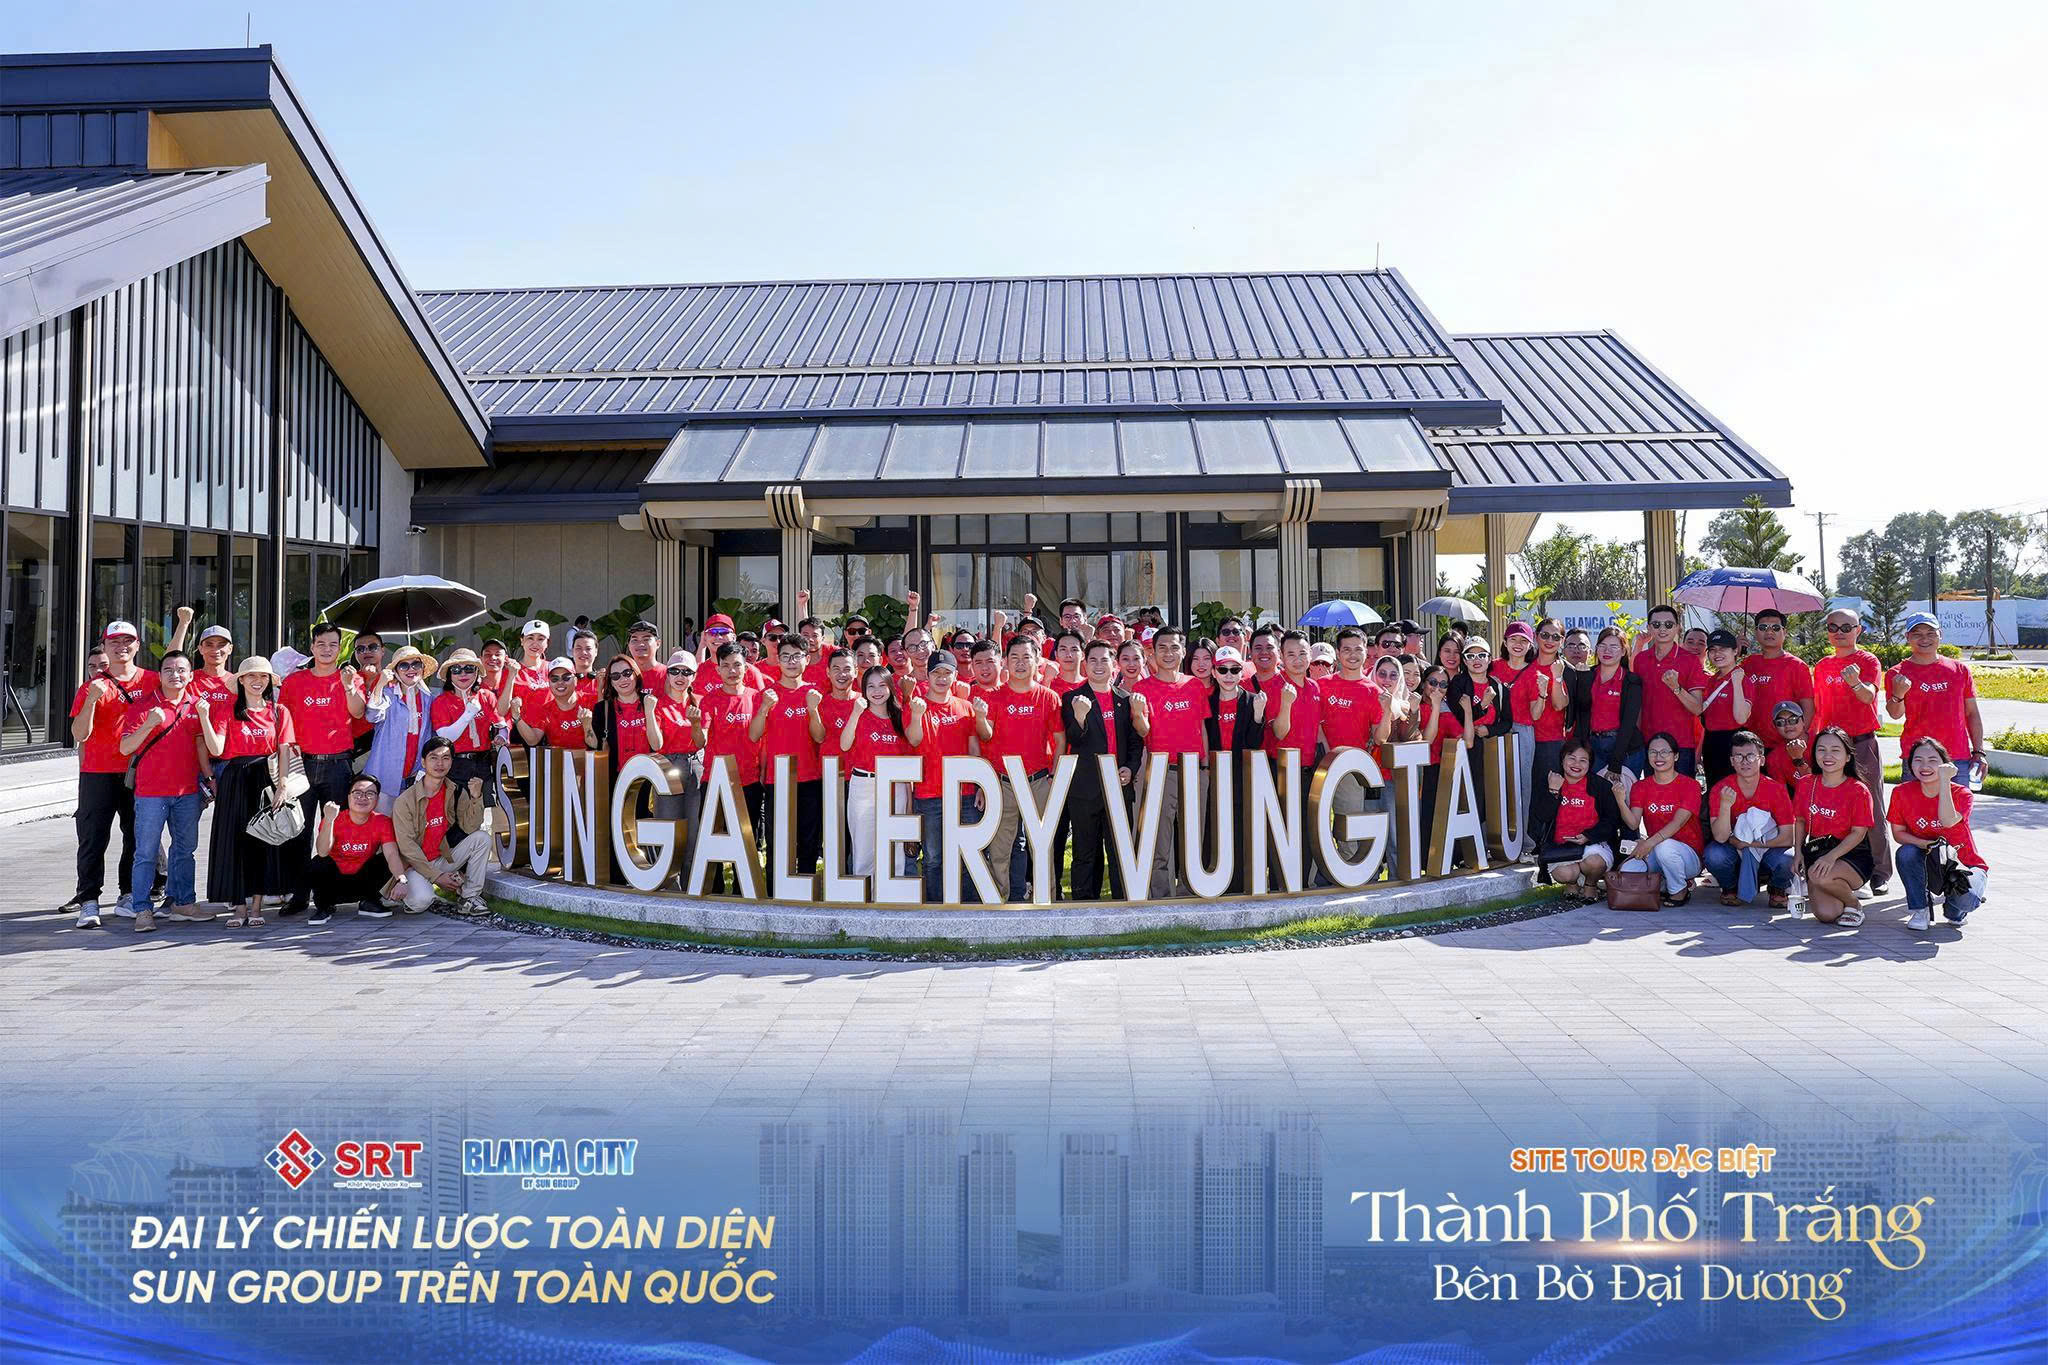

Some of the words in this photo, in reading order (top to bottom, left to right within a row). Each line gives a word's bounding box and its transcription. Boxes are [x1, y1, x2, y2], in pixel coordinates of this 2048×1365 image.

[1565, 616, 1606, 630] BLANCA
[1931, 682, 1949, 691] SRT
[315, 697, 331, 705] SRT
[1338, 698, 1352, 707] SRT
[1175, 701, 1190, 710] SRT
[796, 707, 808, 715] SR
[1018, 706, 1034, 714] SRT
[736, 713, 751, 721] SRT
[1102, 711, 1114, 719] SR
[631, 718, 646, 726] SRT
[941, 715, 958, 724] SRT
[571, 720, 582, 728] SR
[882, 734, 898, 742] SRT
[1570, 798, 1585, 806] SRT
[1660, 804, 1674, 812] SRT
[1819, 807, 1836, 817] SRT
[430, 816, 444, 826] SRT
[1930, 820, 1942, 828] SR
[351, 843, 368, 851] SRT
